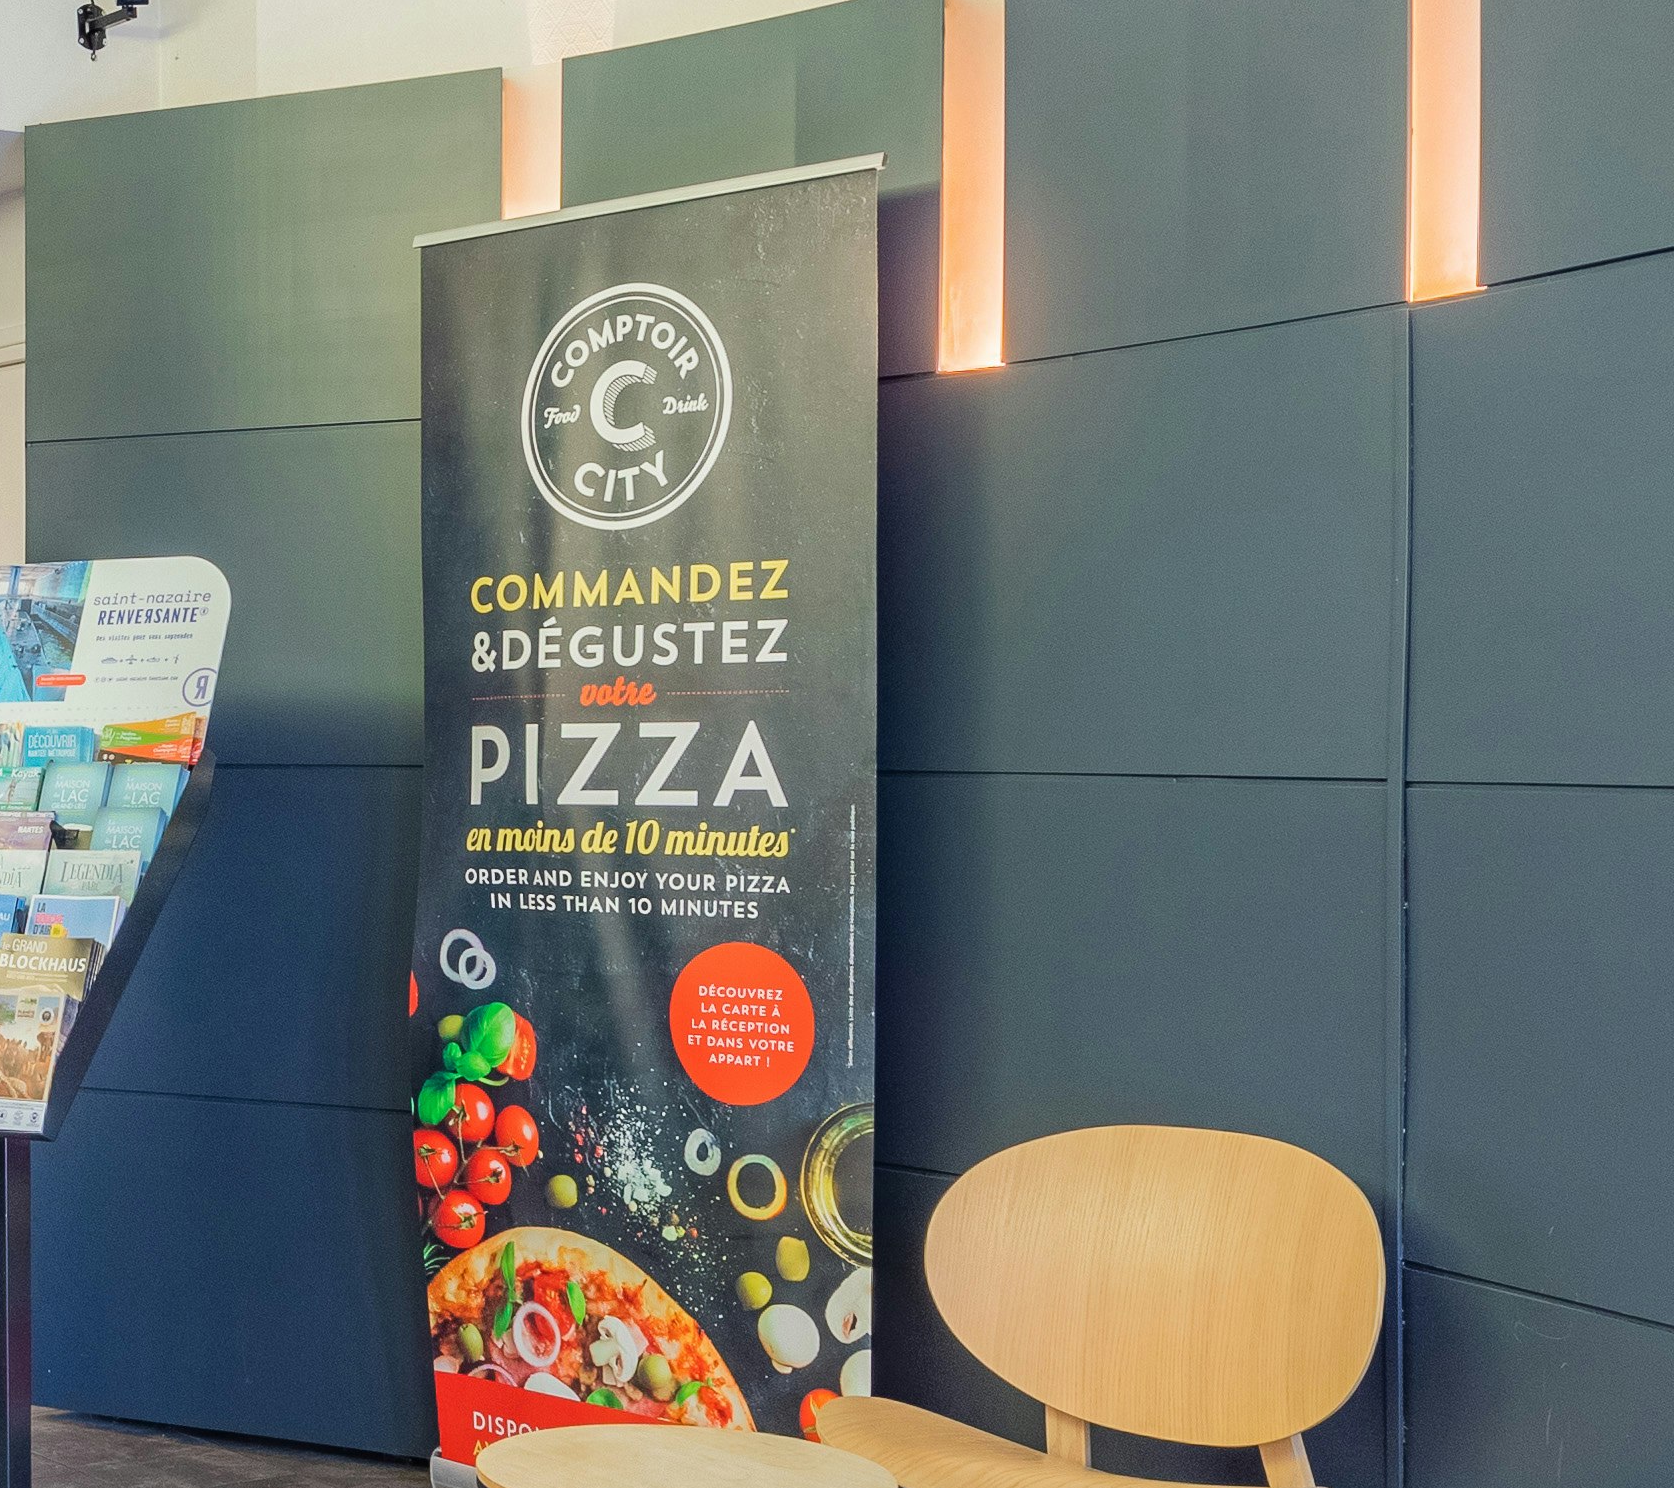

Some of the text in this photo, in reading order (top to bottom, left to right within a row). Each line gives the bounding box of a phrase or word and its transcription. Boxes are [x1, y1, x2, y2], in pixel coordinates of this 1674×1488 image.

[551, 313, 699, 388] COMPTOIR
[543, 393, 709, 429] Food Drink
[573, 450, 669, 502] CITY
[470, 559, 789, 614] COMMANDEZ
[93, 590, 211, 606] saint-nazaire
[471, 616, 788, 673] &DÉGUSTEZ
[579, 676, 657, 706] votre
[470, 720, 789, 807] PIZZA
[60, 789, 89, 803] LAC
[131, 792, 161, 805] LAC
[111, 836, 141, 849] LAC
[466, 826, 492, 852] en
[496, 820, 575, 853] moins
[580, 821, 619, 853] de
[625, 819, 660, 855] 10
[465, 867, 791, 894] ORDER AND ENJOY YOUR PIZZA
[36, 902, 46, 912] LA
[490, 893, 759, 919] IN LESS THAN 10 MINUTES
[12, 938, 47, 953] GRAND
[698, 984, 783, 1001] DÉCOUVREZ
[701, 1002, 781, 1018] LA CARTE À
[691, 1018, 790, 1035] LA RÉCEPTION
[687, 1034, 795, 1053] ET DANS VOTRE
[709, 1053, 761, 1067] APPART
[473, 1410, 543, 1438] DISPO
